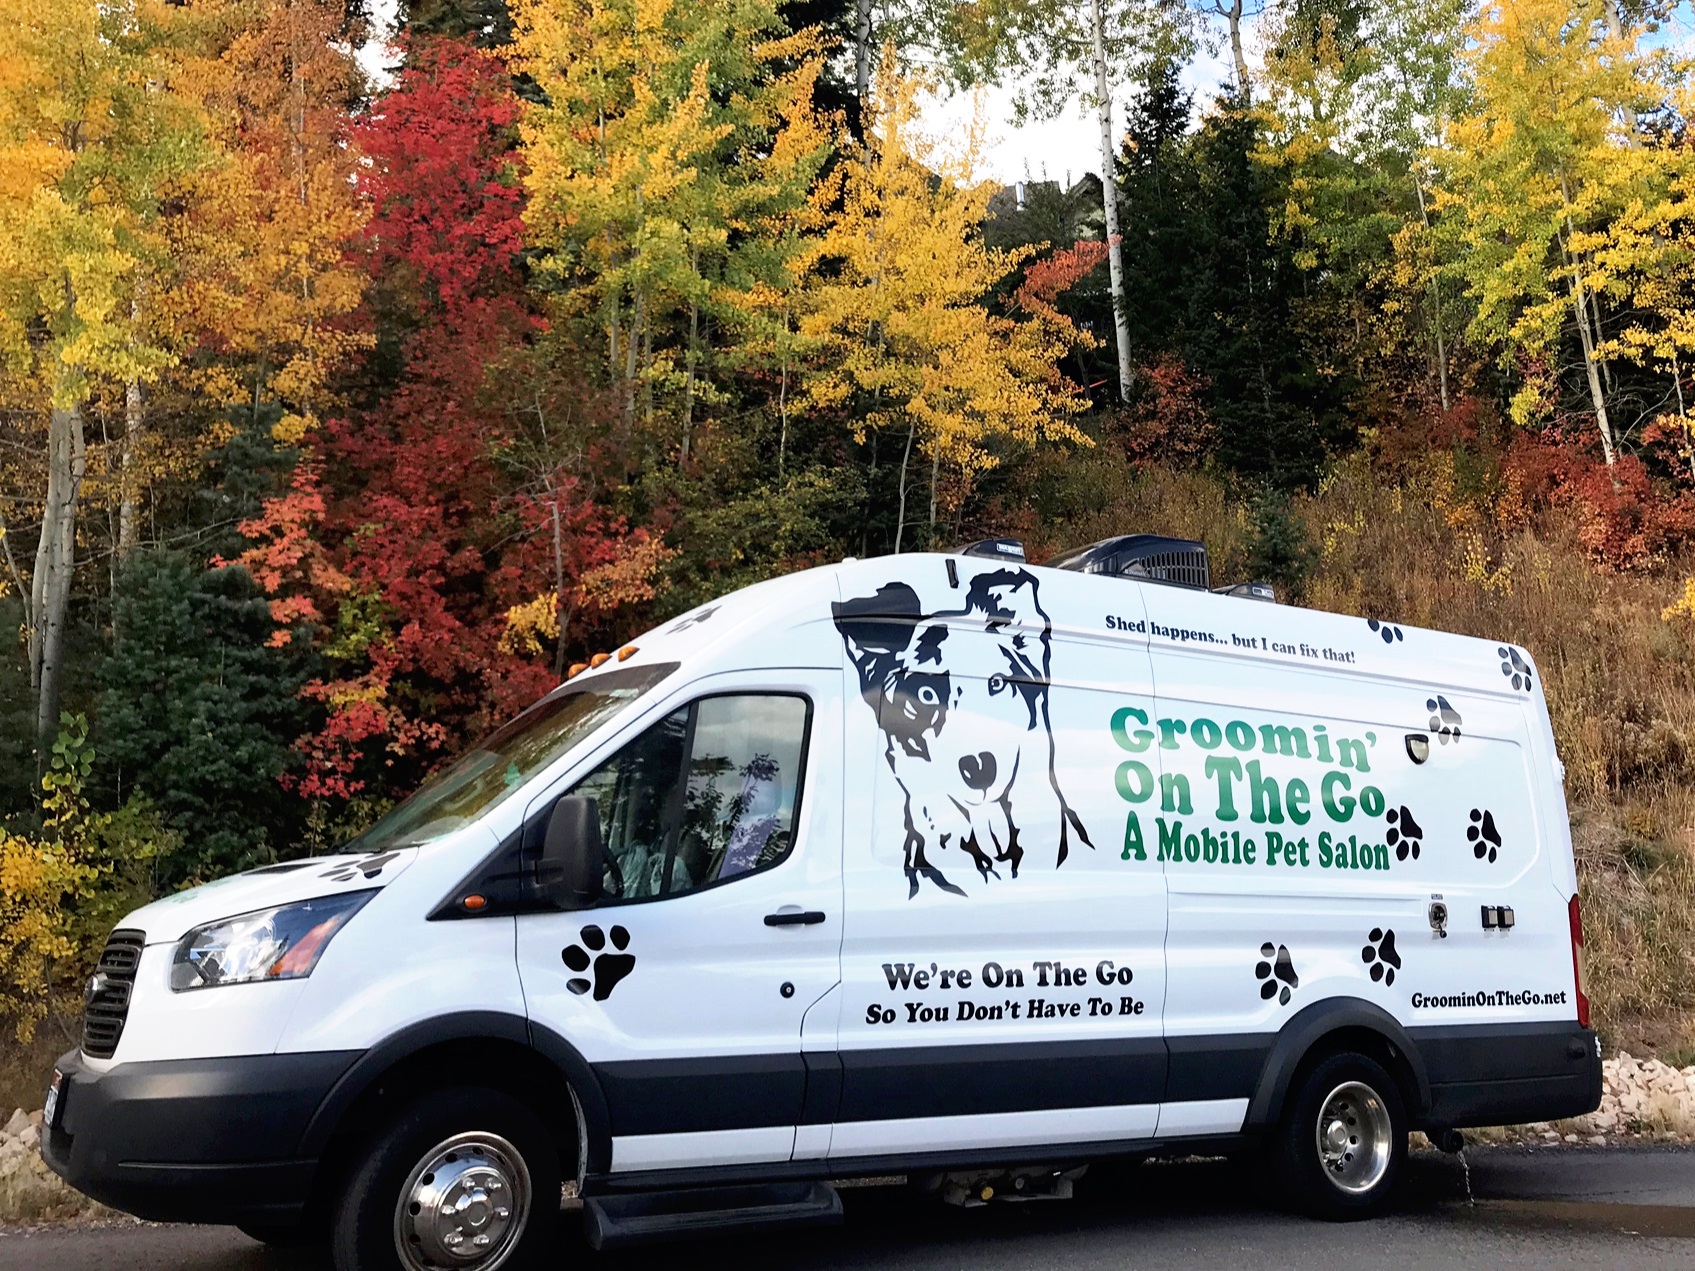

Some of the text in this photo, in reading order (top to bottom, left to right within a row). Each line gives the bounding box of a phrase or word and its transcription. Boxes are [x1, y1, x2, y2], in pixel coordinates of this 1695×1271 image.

[1105, 614, 1355, 664] Shed happens... but I can fix that!
[1110, 706, 1376, 773] Groomin'
[1114, 755, 1385, 826] On The Go
[1120, 810, 1390, 871] A Mobile Pet Salon
[881, 960, 1133, 991] We're On The Go
[1411, 990, 1567, 1008] GroominOnTheGo.net
[865, 996, 1144, 1025] So You Don't Have To Be
